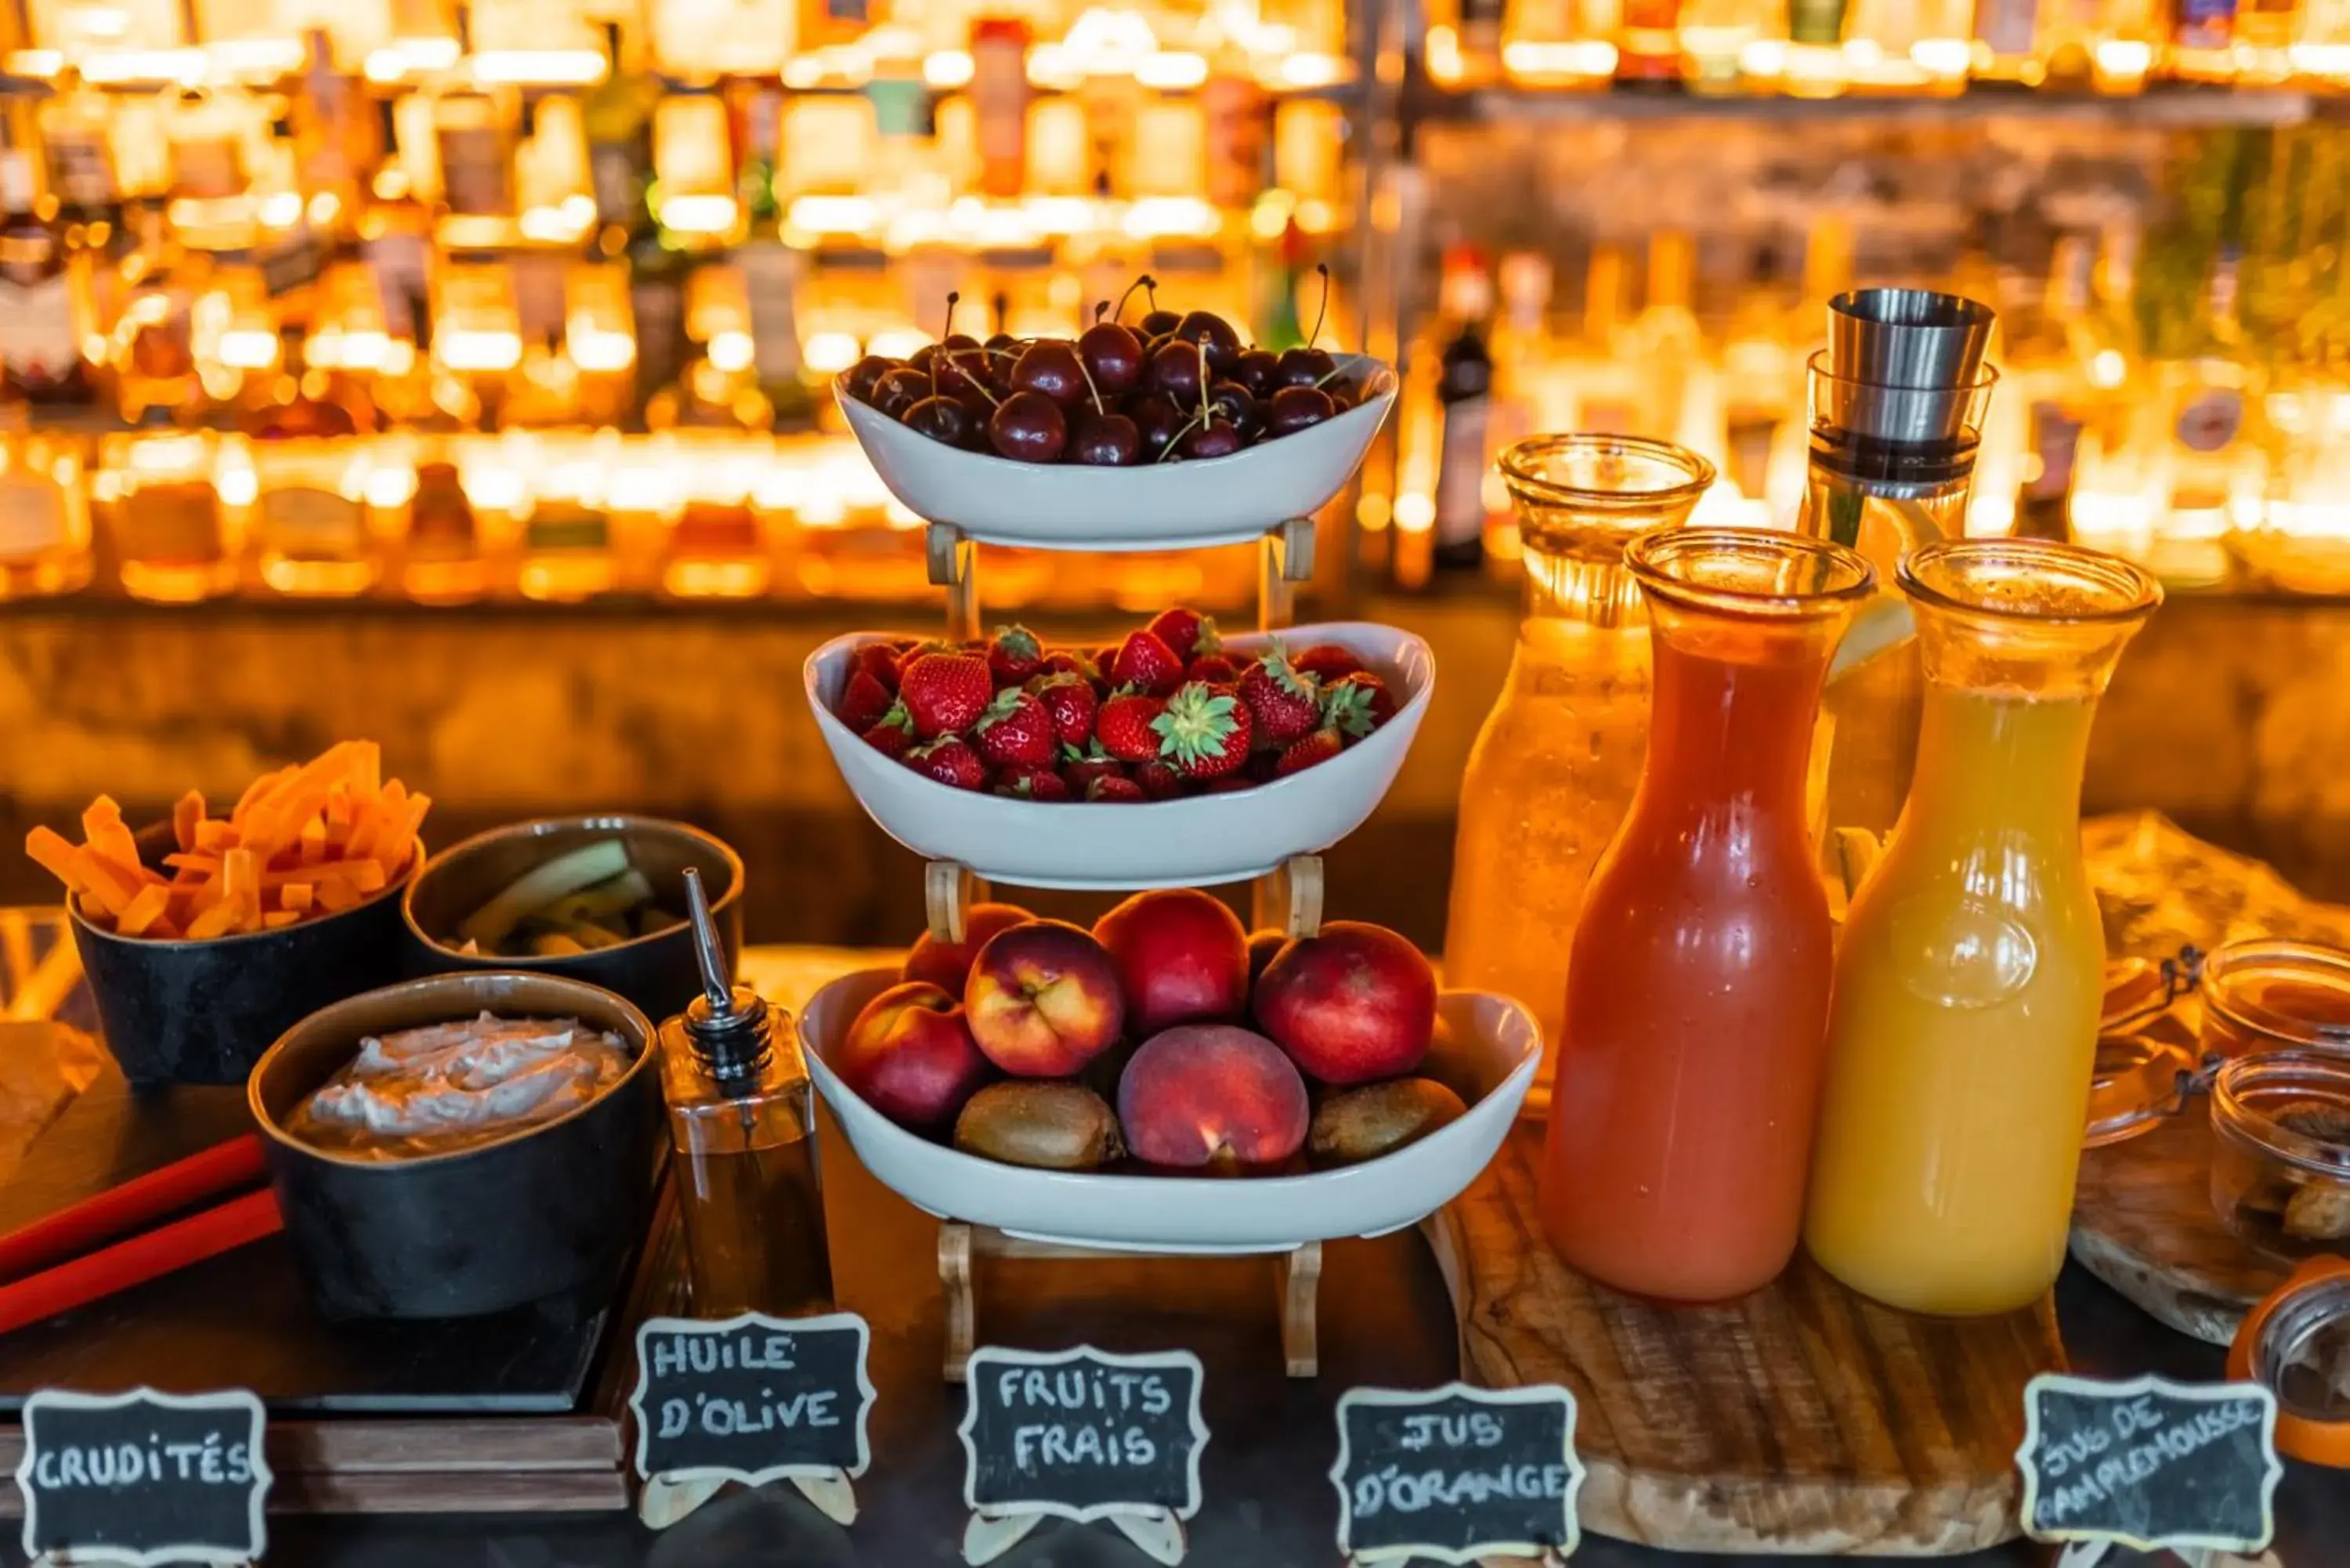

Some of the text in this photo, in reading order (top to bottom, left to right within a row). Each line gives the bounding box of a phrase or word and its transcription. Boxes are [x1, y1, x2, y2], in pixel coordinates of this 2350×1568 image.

[1401, 1412, 1505, 1451] JUS
[2041, 1396, 2164, 1478] JUS DE
[1354, 1463, 1569, 1518] D'ORANGE
